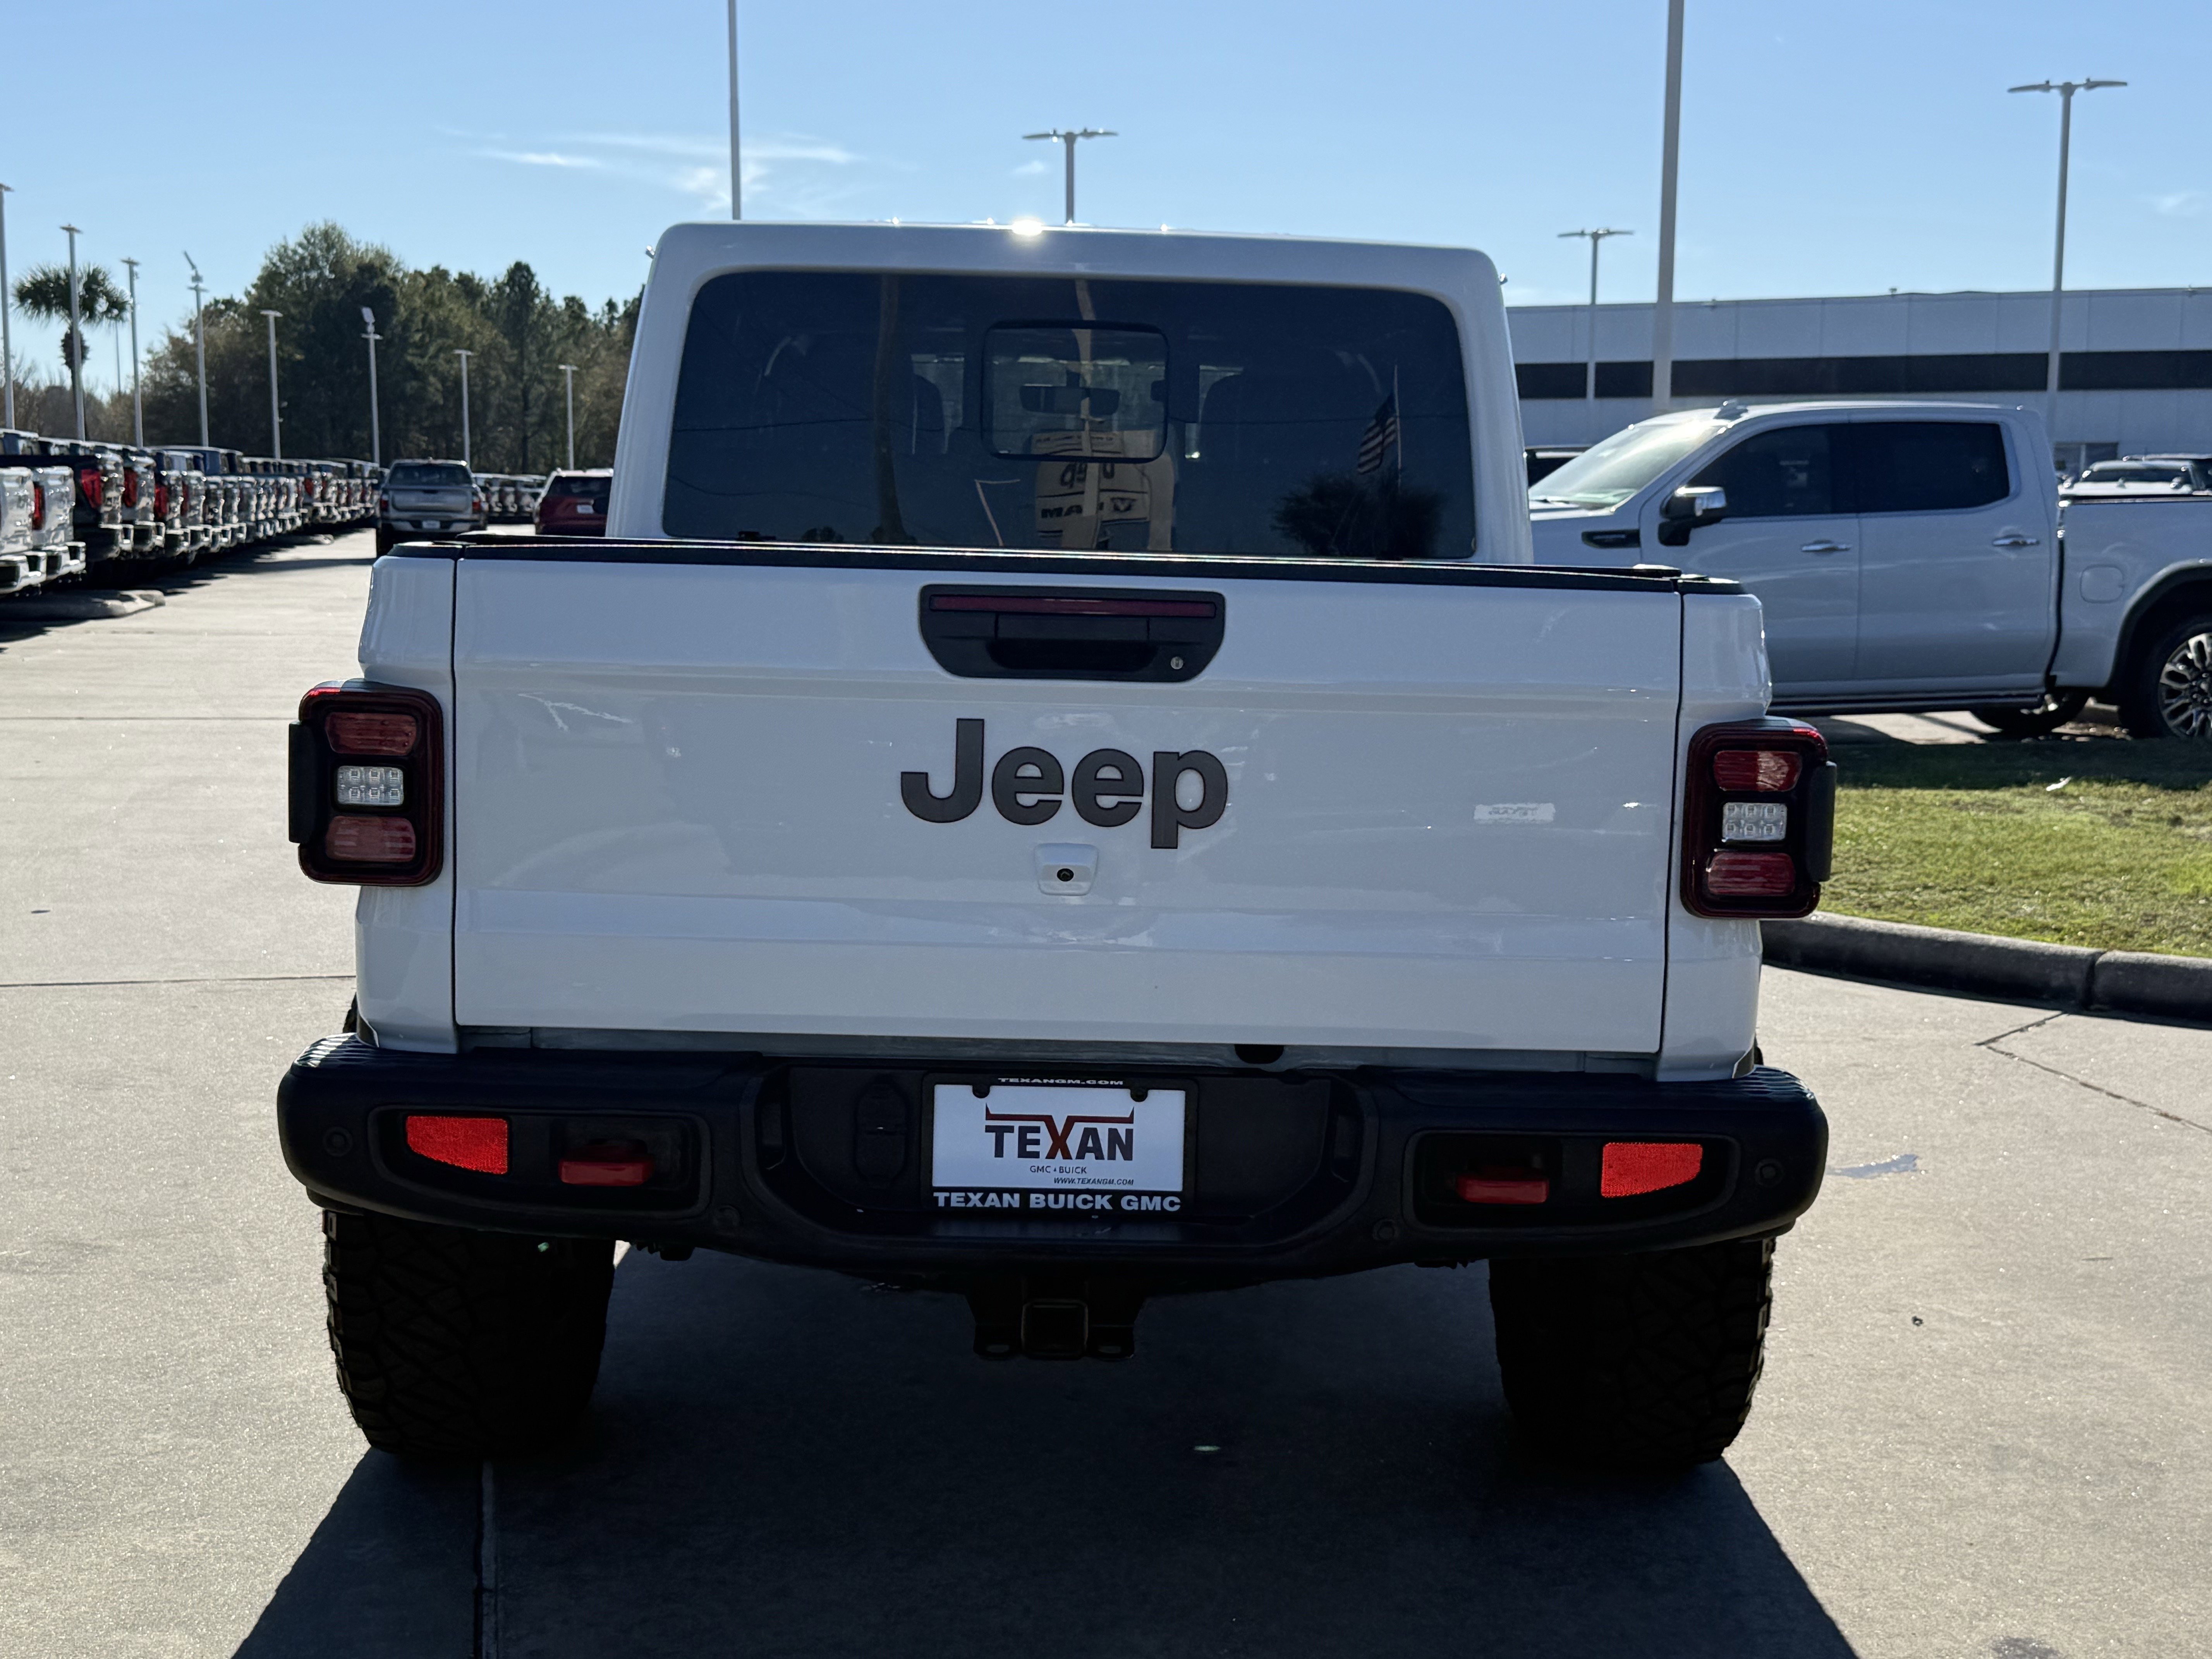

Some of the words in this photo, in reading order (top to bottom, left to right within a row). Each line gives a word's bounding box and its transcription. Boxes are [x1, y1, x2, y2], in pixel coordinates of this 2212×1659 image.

[900, 718, 1228, 849] Jeep
[998, 1077, 1123, 1085] TEXANGM.COM
[985, 1104, 1134, 1161] TEXAN
[1030, 1165, 1051, 1173] GMC
[1059, 1166, 1087, 1174] BUICK
[1054, 1177, 1134, 1186] WWW.TEXANGM.COM
[933, 1192, 1020, 1208] TEXAN
[1029, 1194, 1113, 1210] BUICK
[1121, 1195, 1181, 1211] GMC
